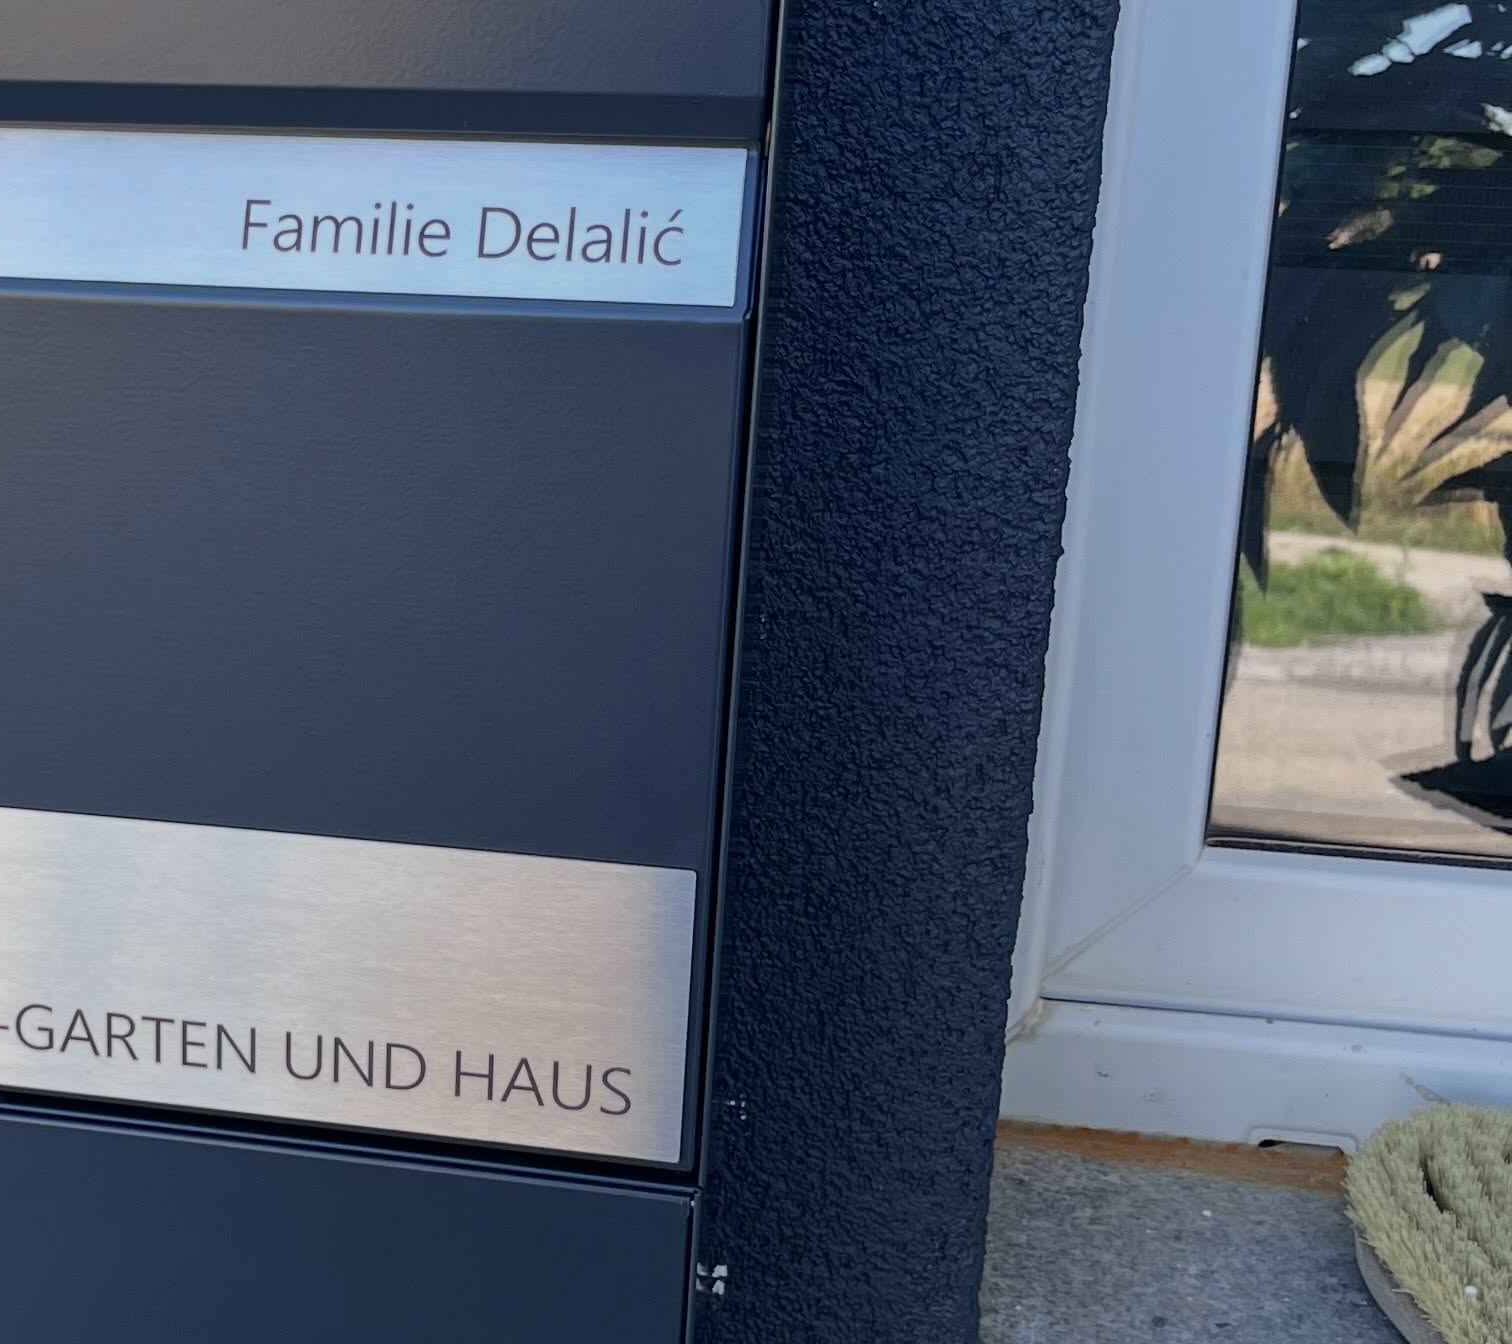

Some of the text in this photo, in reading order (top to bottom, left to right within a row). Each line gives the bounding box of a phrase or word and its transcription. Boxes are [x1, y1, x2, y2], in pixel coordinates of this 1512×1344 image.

[241, 199, 685, 266] Familie Delalić
[285, 1029, 427, 1091] UND
[453, 1049, 634, 1116] HAUS
